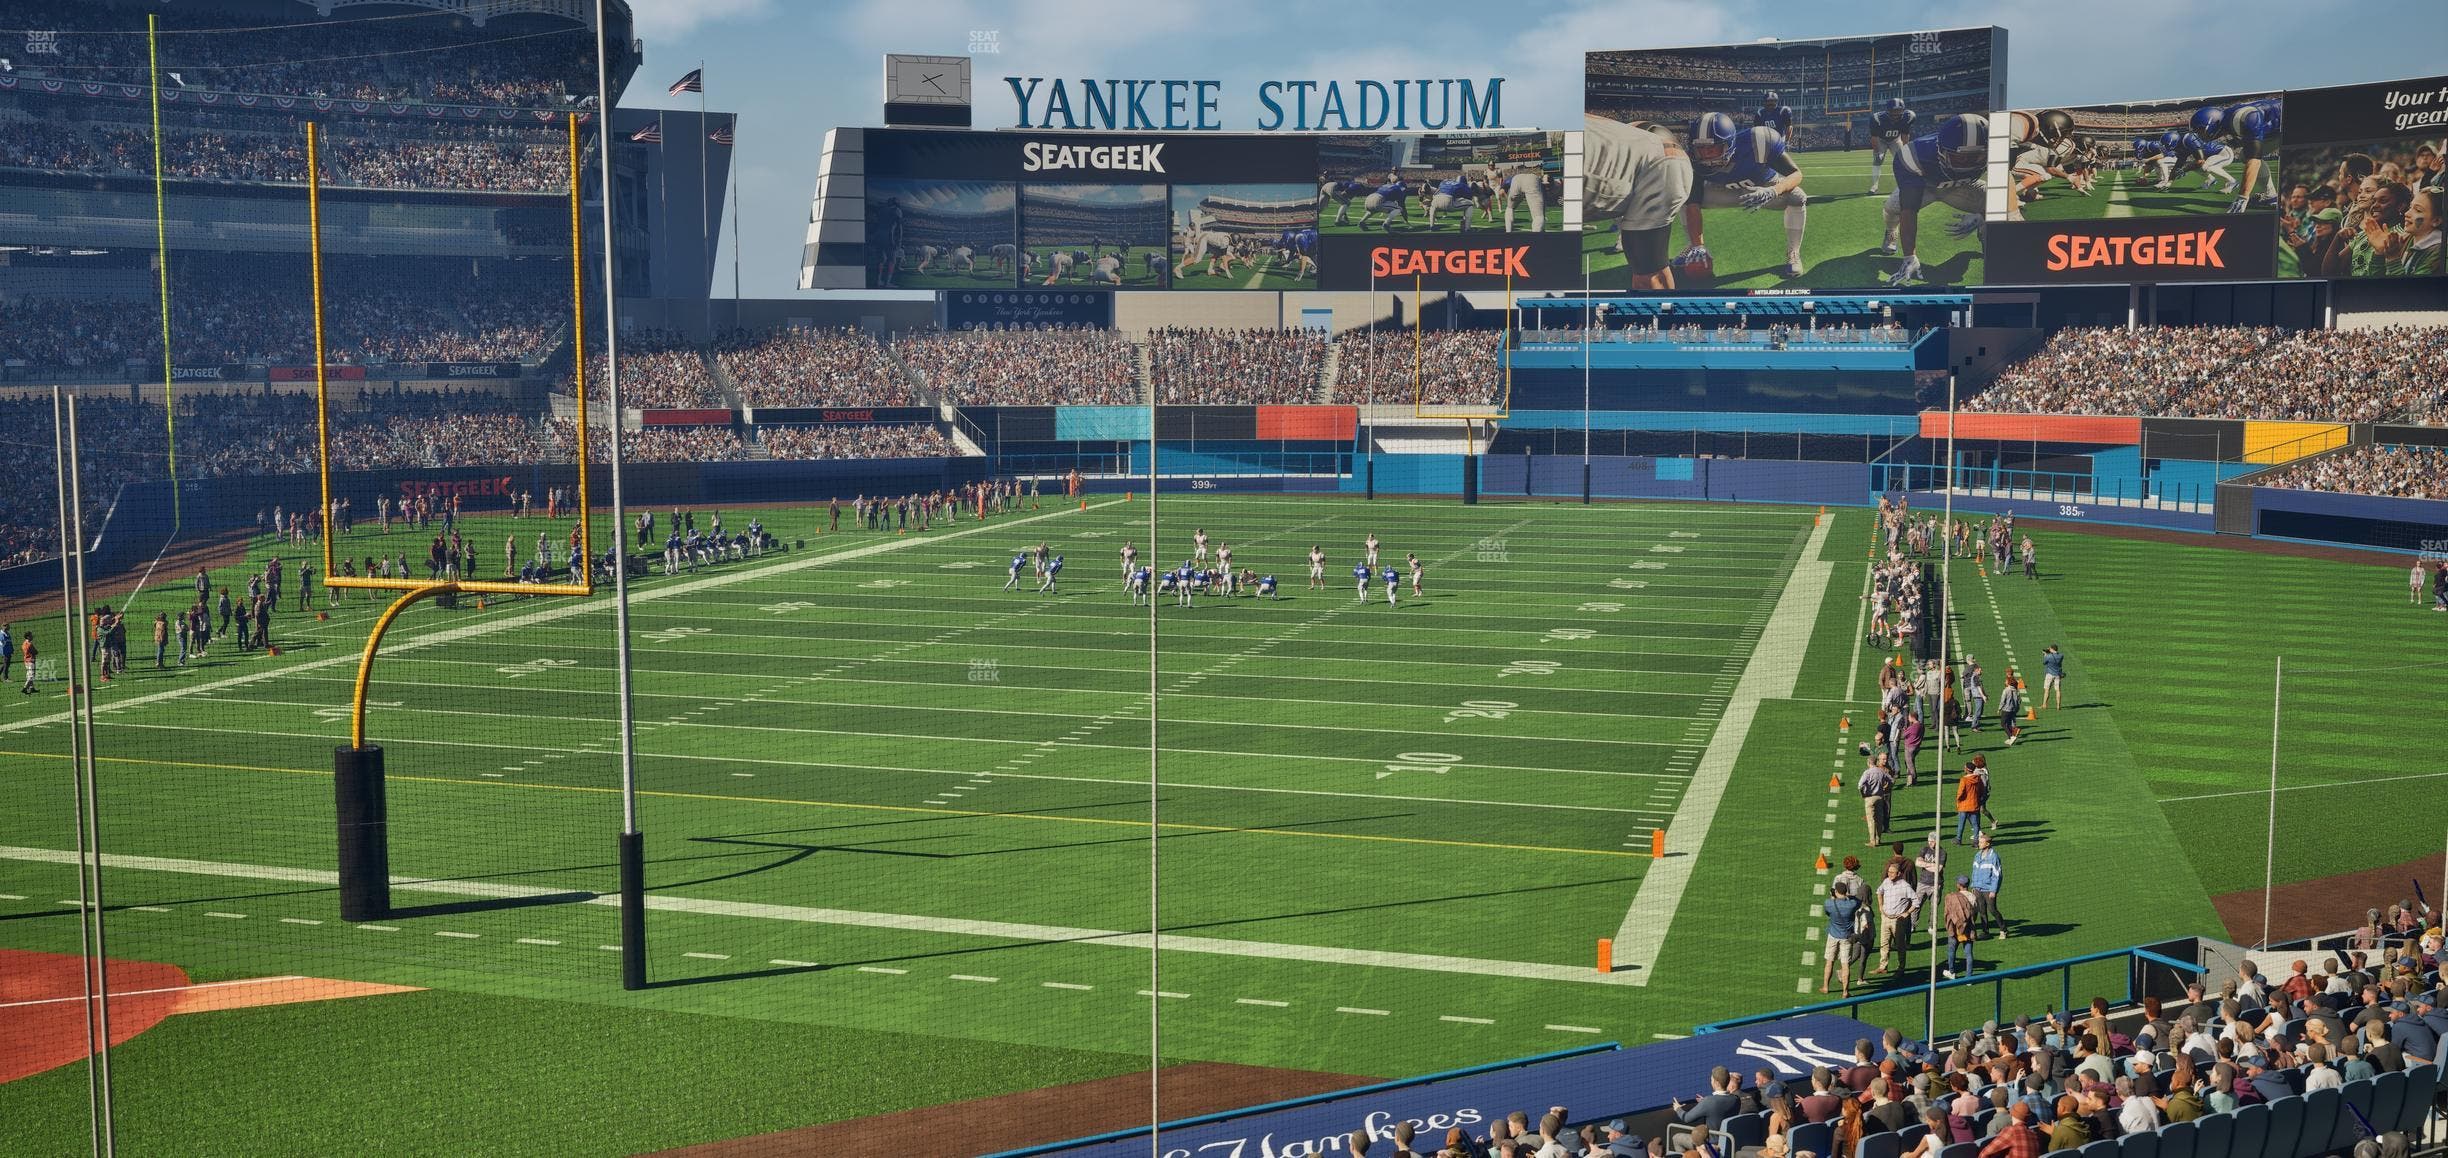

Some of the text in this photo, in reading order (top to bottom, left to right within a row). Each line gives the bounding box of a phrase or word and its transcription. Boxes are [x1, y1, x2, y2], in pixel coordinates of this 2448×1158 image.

[1003, 77, 1505, 131] YANKEE STADIUM
[2438, 87, 2448, 103] t
[1023, 142, 1166, 172] SEATGEEK
[2047, 228, 2226, 271] SEATGEEK
[1371, 245, 1531, 277] SEATGEEK
[172, 367, 221, 378] SEATGEEK
[449, 365, 497, 376] SEATGEEK
[823, 410, 875, 421] SEATGEEK
[400, 476, 512, 499] SEATGEEK
[1449, 700, 1519, 720] 20
[1384, 752, 1463, 774] 10
